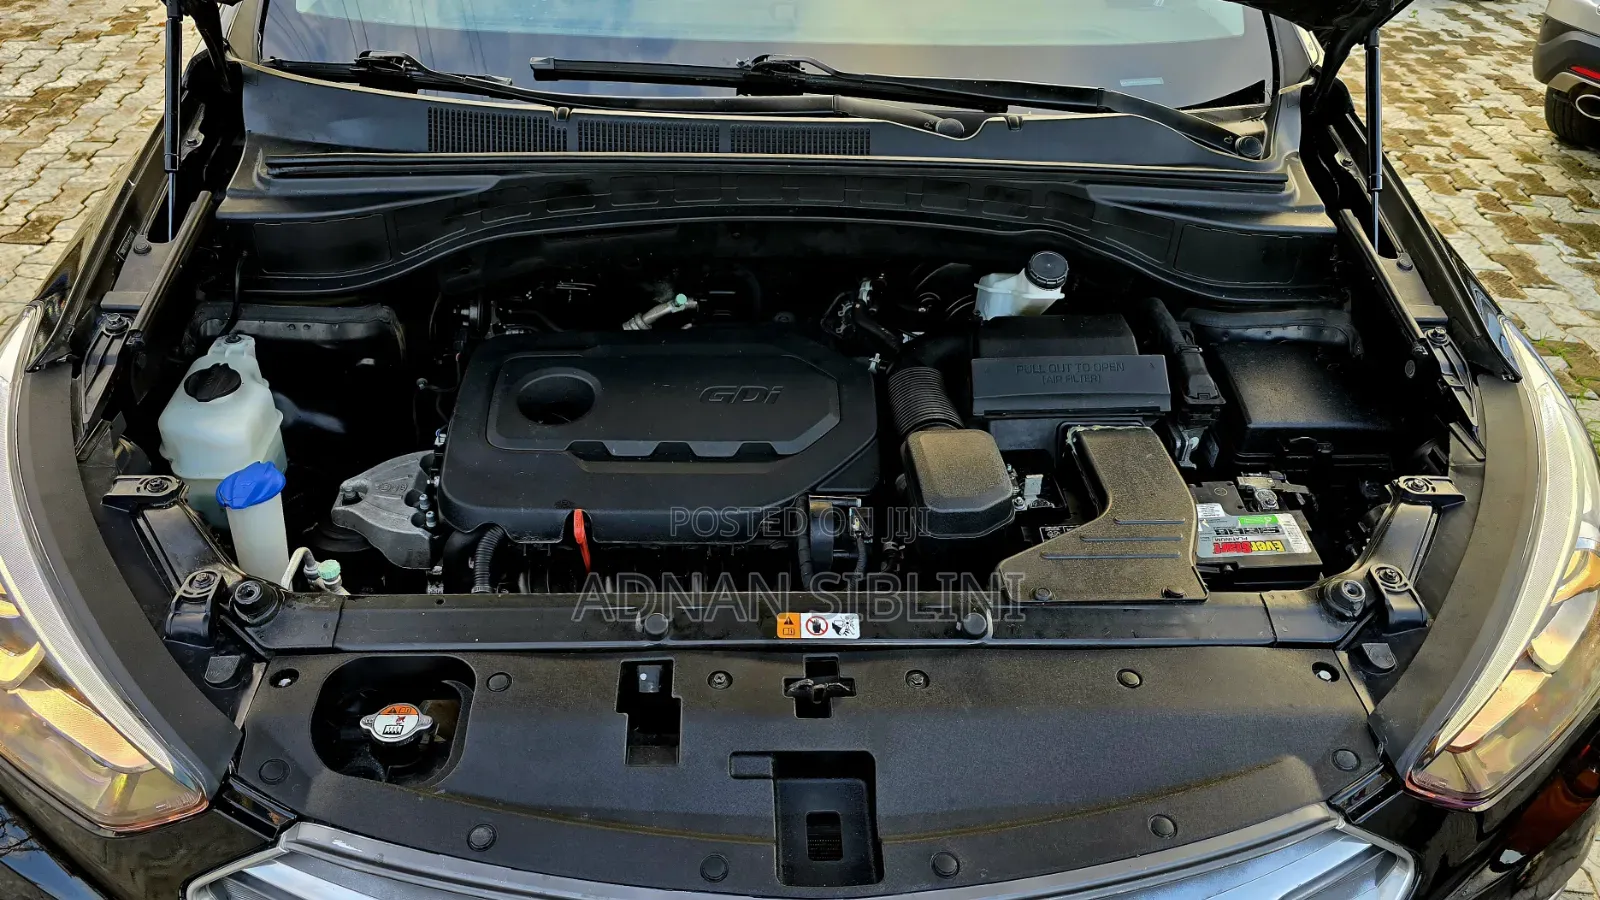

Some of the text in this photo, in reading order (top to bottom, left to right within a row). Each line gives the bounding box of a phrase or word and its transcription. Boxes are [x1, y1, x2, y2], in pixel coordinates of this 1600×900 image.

[1016, 362, 1125, 374] PULL OUT TO OPEN
